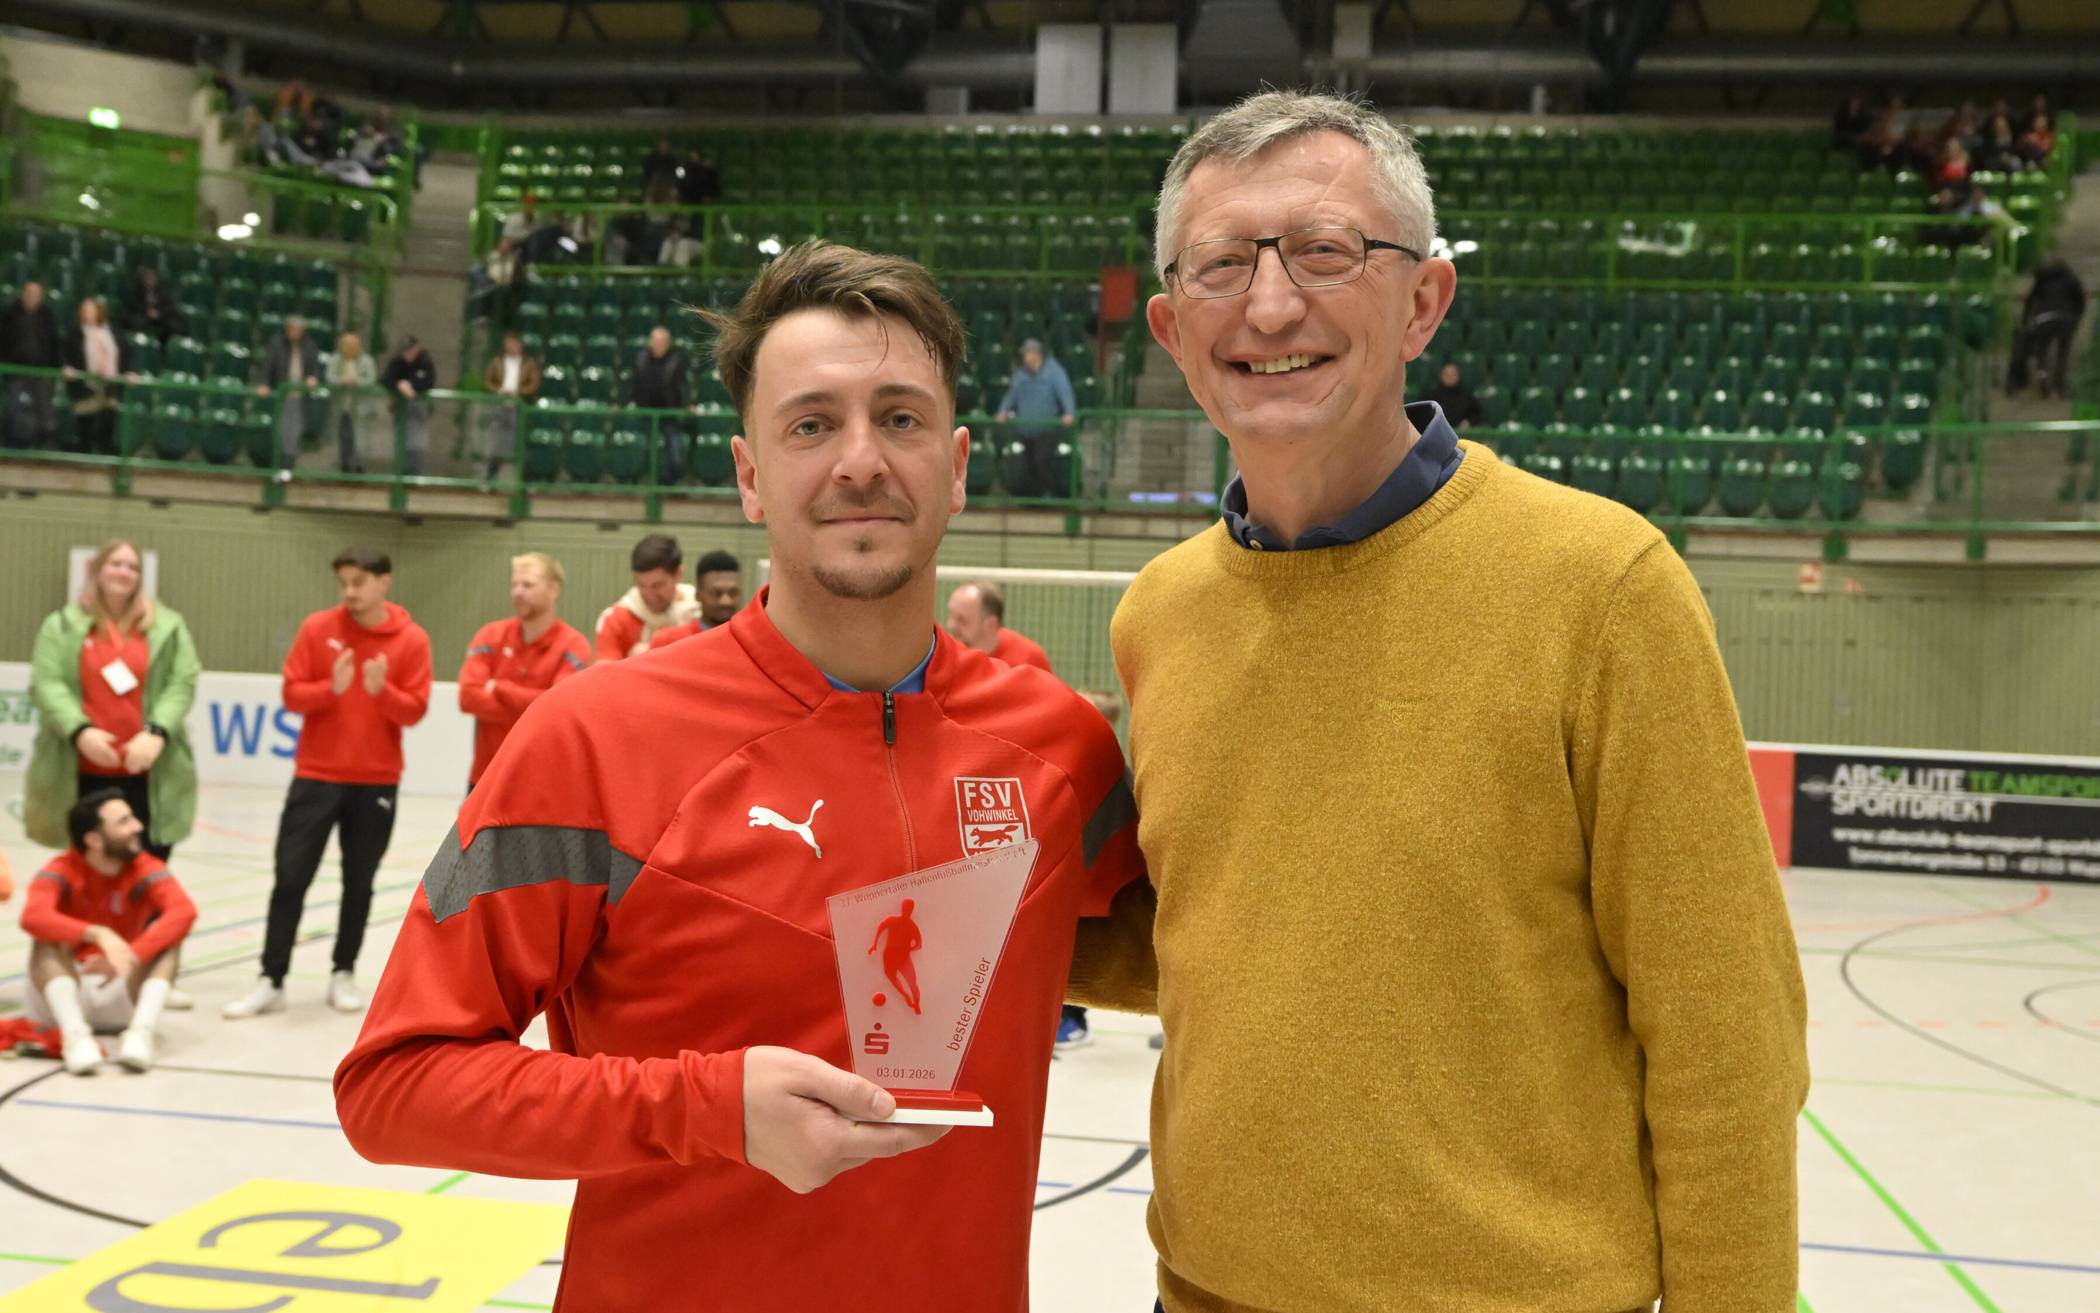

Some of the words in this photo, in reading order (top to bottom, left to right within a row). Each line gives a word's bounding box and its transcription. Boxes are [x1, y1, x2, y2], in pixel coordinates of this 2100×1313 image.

[1834, 763, 1966, 793] ABSOLUTE
[963, 782, 1011, 809] FSV
[1832, 789, 1996, 823] SPORTDIREKT
[967, 808, 1020, 822] VOHWINKEL
[947, 1008, 972, 1051] bester
[963, 957, 991, 1006] Spieler
[876, 1067, 936, 1080] 03.01.2026
